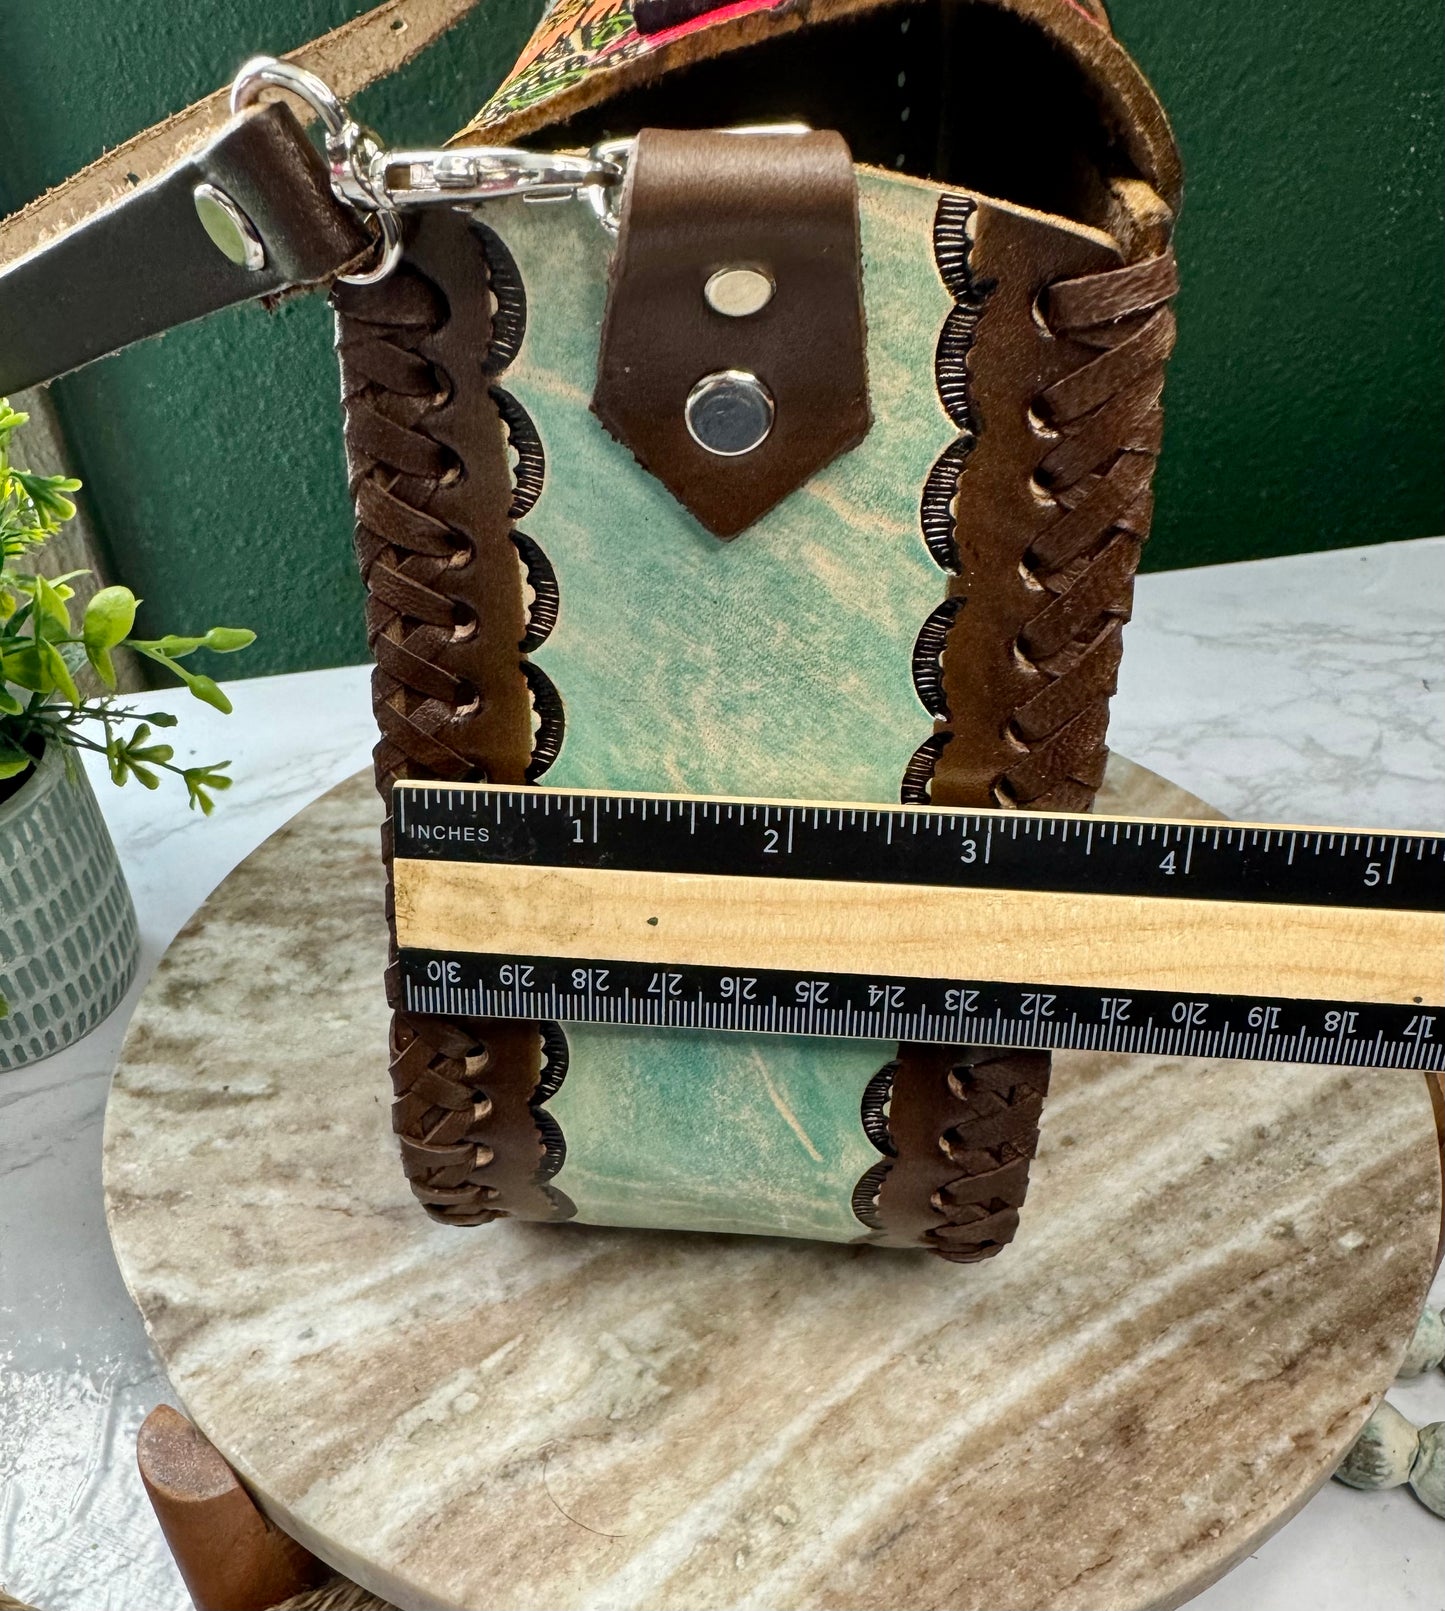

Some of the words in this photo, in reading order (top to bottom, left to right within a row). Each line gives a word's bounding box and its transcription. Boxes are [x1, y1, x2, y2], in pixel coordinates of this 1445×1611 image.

[410, 824, 490, 842] INCHES
[571, 819, 584, 843] 1
[763, 829, 778, 853] 2
[960, 839, 977, 864] 3
[1158, 850, 1177, 875] 4
[1363, 862, 1381, 886] 5
[427, 960, 462, 983] 30
[499, 964, 535, 987] 29
[571, 968, 610, 992] 28
[647, 972, 683, 996] 27
[720, 976, 758, 1000] 26
[795, 980, 830, 1003] 25
[868, 984, 906, 1008] 24
[944, 989, 980, 1012] 23
[1019, 993, 1057, 1016] 22
[1100, 998, 1133, 1021] 21
[1171, 1002, 1209, 1025] 20
[1248, 1006, 1282, 1029] 19
[1324, 1010, 1359, 1034] 18
[1403, 1015, 1437, 1038] 17
